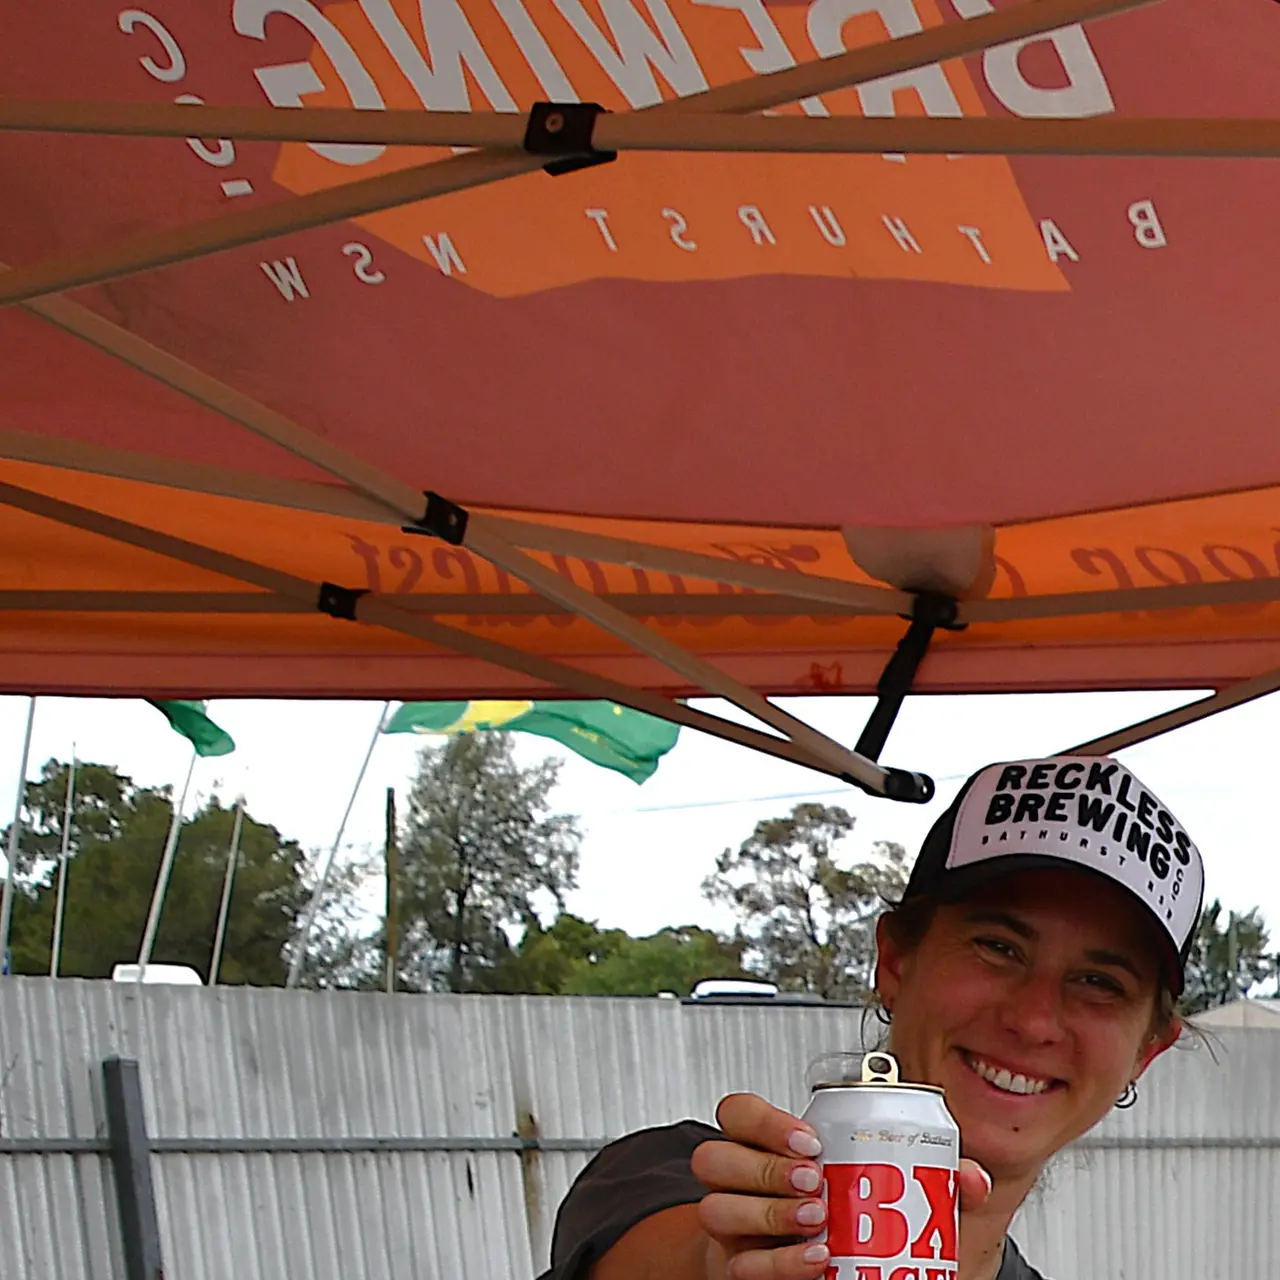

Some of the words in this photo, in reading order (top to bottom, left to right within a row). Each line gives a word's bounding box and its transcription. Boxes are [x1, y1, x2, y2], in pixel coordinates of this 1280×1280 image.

[982, 830, 1126, 866] BATHURST
[985, 793, 1171, 880] BREWING
[996, 763, 1191, 866] RECKLESS
[823, 1163, 958, 1261] BX
